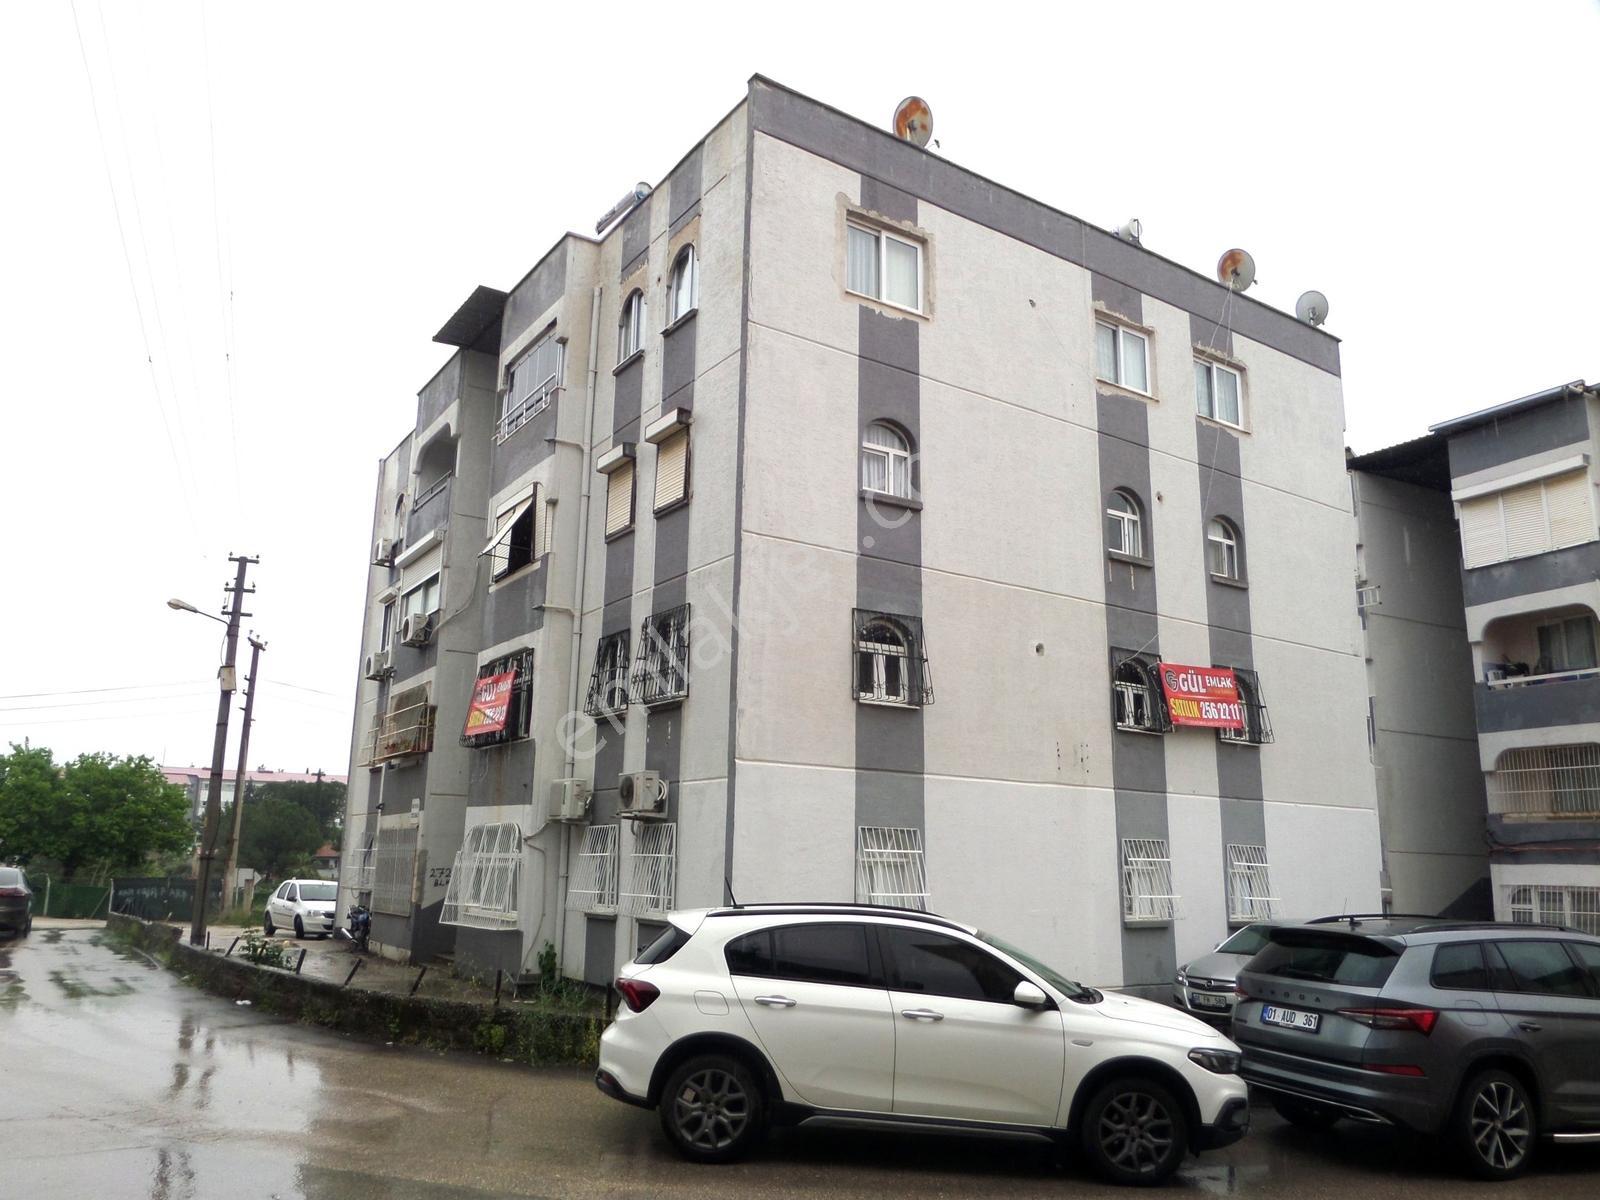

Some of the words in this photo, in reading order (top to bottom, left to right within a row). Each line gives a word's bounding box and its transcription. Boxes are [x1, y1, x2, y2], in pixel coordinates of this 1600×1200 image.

[1178, 670, 1206, 693] GÜL
[1205, 675, 1233, 688] EMLAK
[1200, 701, 1219, 719] 256
[1218, 703, 1230, 720] 22
[1230, 703, 1241, 720] 11
[1267, 1008, 1277, 1020] 01
[1281, 1010, 1297, 1023] AUD
[1303, 1014, 1318, 1028] 361
